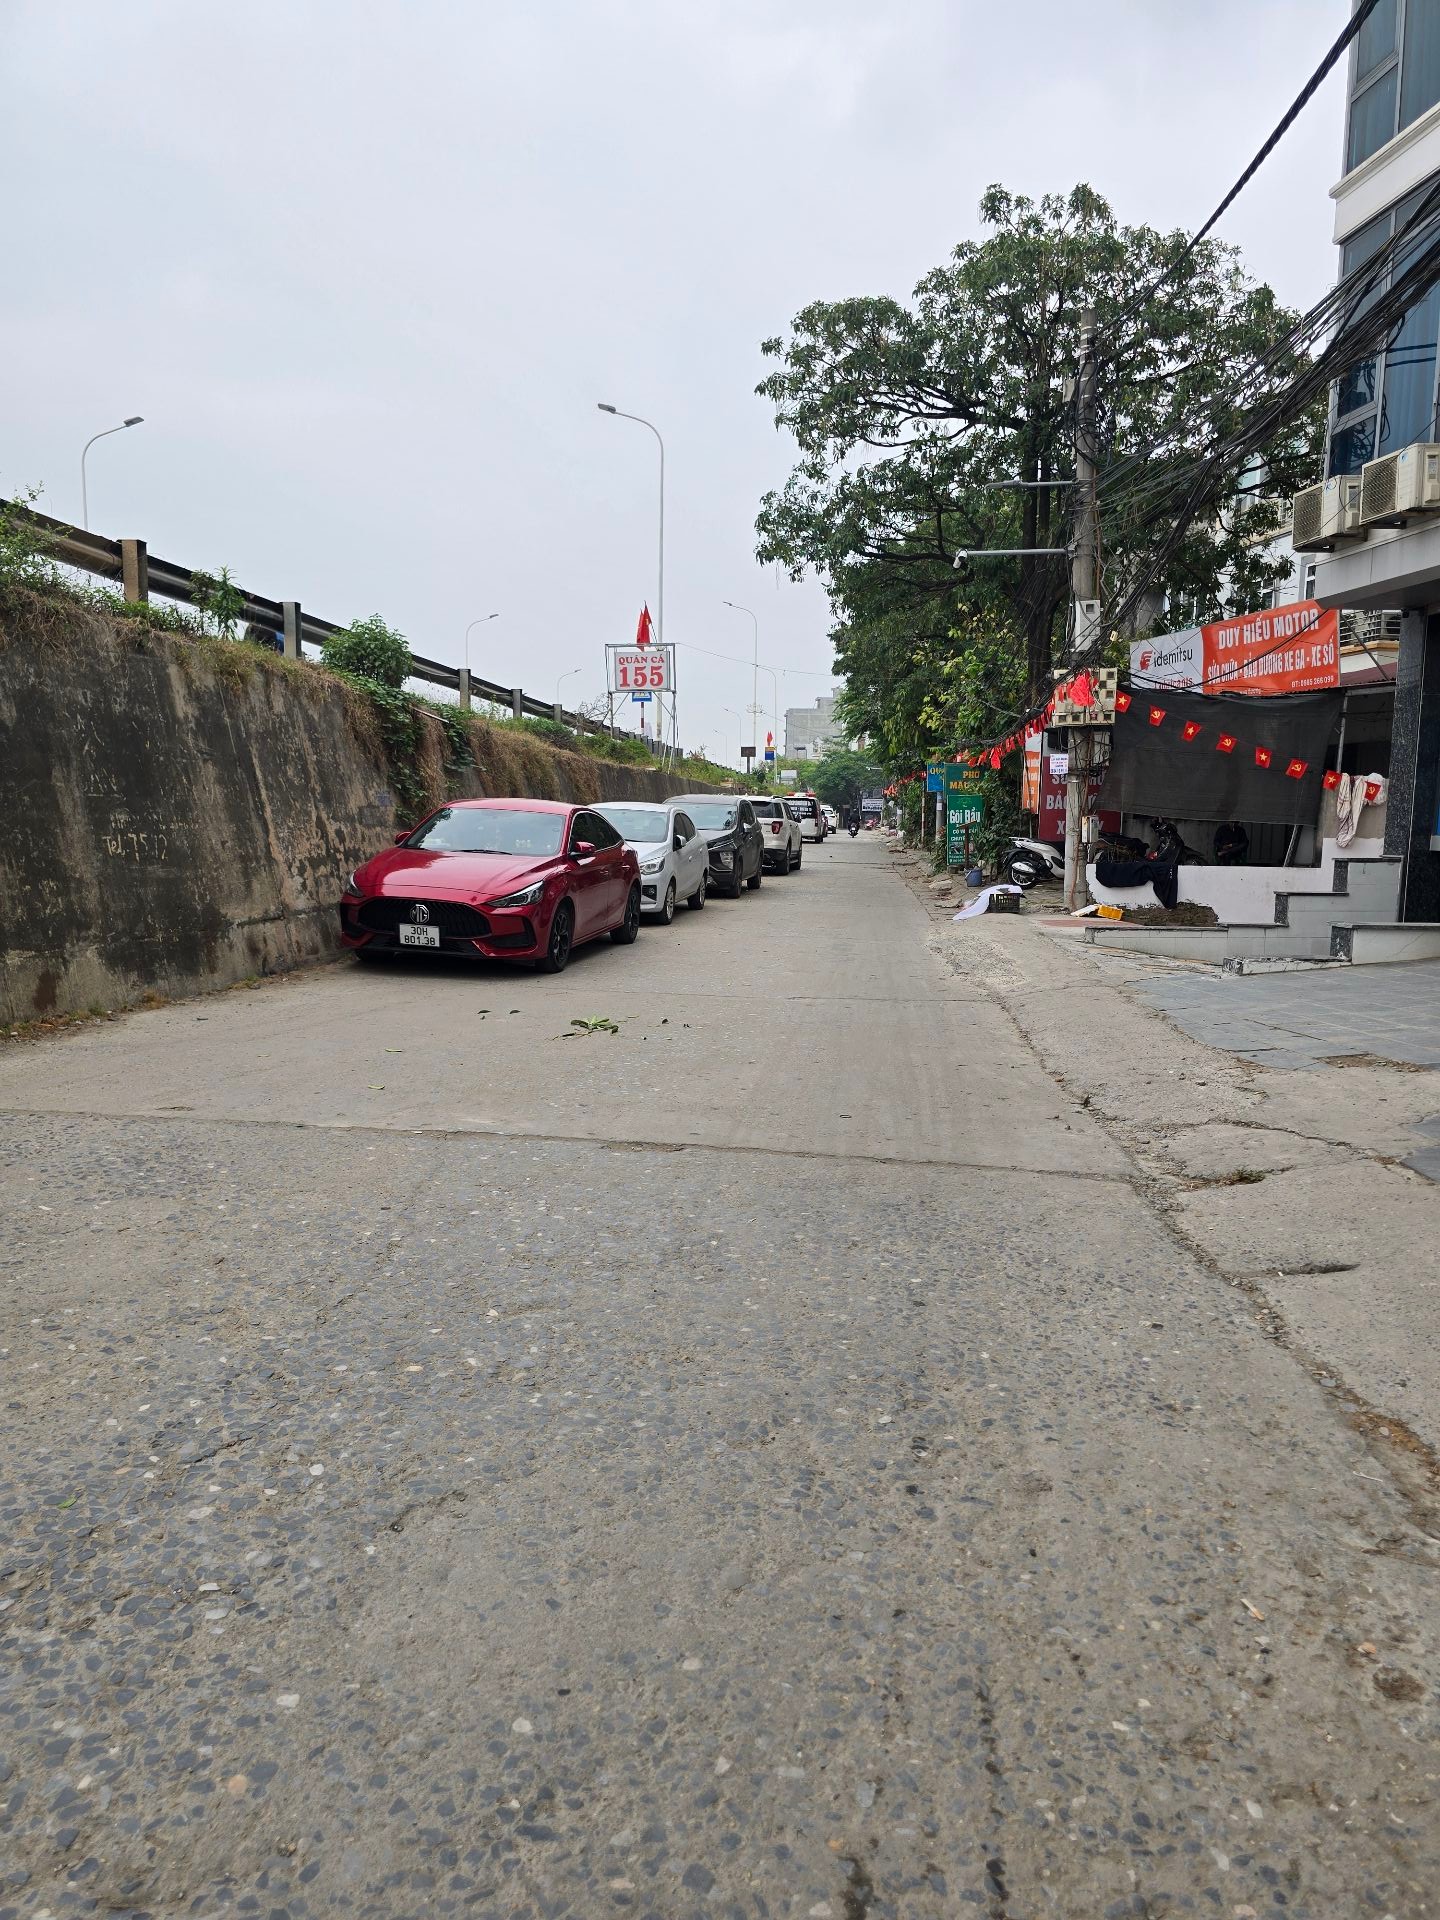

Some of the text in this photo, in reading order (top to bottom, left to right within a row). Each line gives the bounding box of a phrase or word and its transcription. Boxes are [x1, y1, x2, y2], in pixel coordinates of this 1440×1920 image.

[1218, 608, 1319, 650] DUY HIẾU MOTOR
[618, 653, 665, 666] QUÁN CÁ
[1153, 647, 1193, 667] idemitsu
[1283, 650, 1294, 672] XE
[1295, 648, 1306, 670] GA
[1311, 645, 1322, 668] XE
[1322, 634, 1335, 666] SỐ
[619, 665, 664, 688] 155
[410, 904, 429, 924] MG
[404, 935, 436, 946] 801.38
[410, 926, 428, 936] 30H
